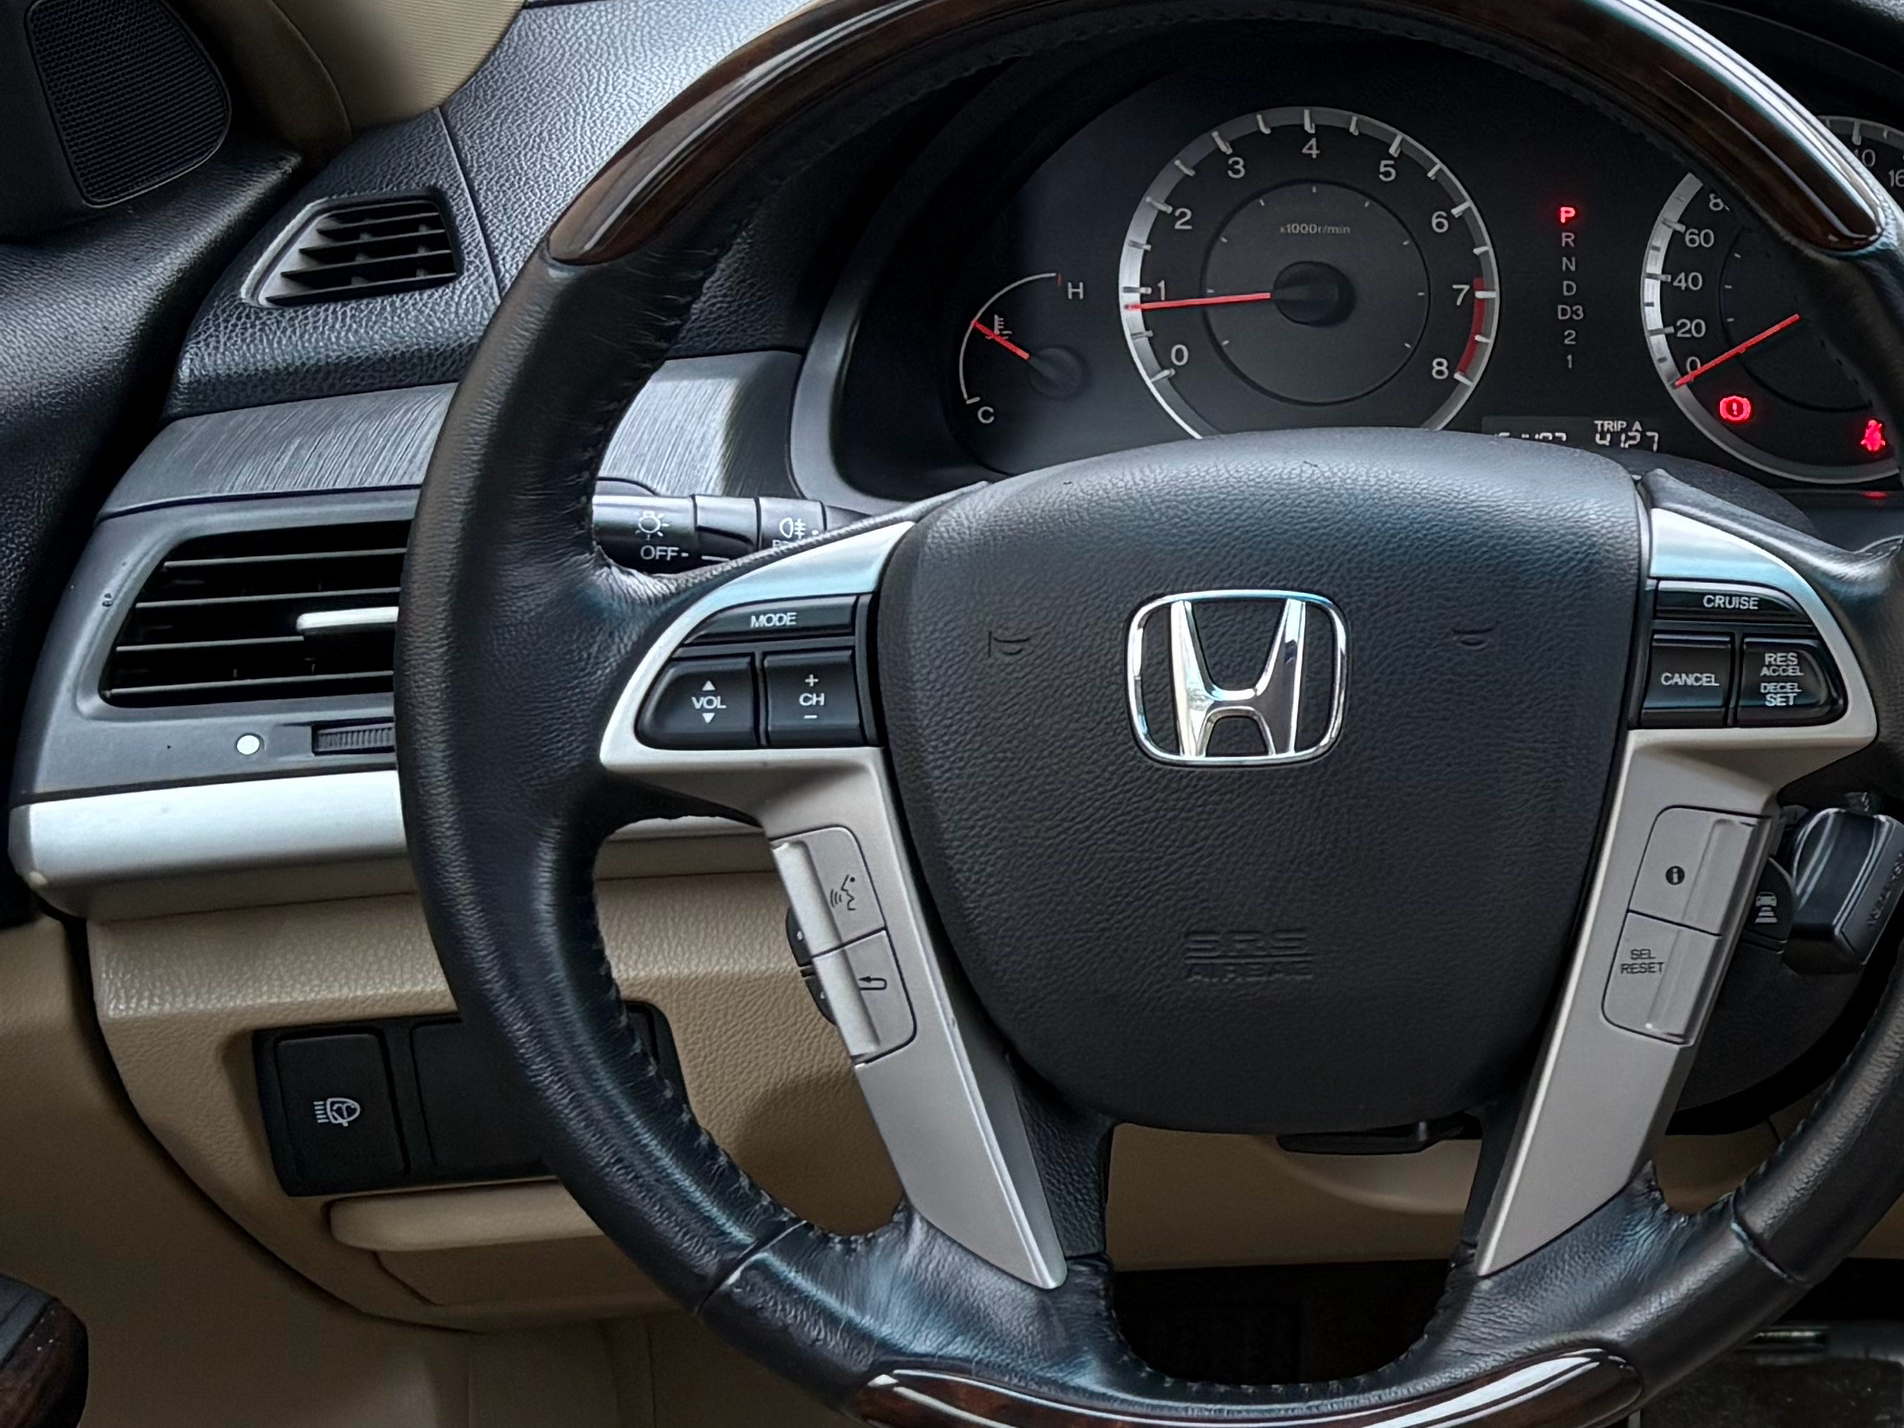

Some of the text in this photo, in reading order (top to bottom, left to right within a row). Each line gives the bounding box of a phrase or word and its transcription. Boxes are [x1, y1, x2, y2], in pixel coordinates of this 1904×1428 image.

[1301, 137, 1321, 159] 4
[1226, 156, 1246, 180] 3
[1378, 159, 1397, 182] 5
[1708, 192, 1730, 212] 8
[1173, 207, 1193, 230] 2
[1430, 210, 1450, 233] 6
[1559, 206, 1576, 224] P
[1561, 231, 1575, 248] R
[1684, 228, 1715, 248] 60
[1562, 256, 1576, 272] N
[1562, 280, 1577, 296] D
[1672, 272, 1703, 291] 40
[1067, 282, 1084, 300] H
[1156, 280, 1167, 301] 1
[1452, 284, 1469, 305] 7
[1557, 304, 1585, 320] D3
[1676, 318, 1706, 338] 20
[1563, 329, 1577, 345] 2
[1170, 344, 1189, 366] 0
[1566, 354, 1573, 369] 1
[1430, 358, 1449, 380] 8
[976, 406, 995, 424] C
[1594, 420, 1643, 432] TRIP A
[640, 545, 679, 562] OFF
[1702, 594, 1760, 610] CRUISE
[749, 612, 797, 628] MODE
[1764, 652, 1798, 666] RES
[1660, 672, 1720, 687] CANCEL
[1760, 666, 1804, 677] ACCEL
[1760, 682, 1802, 693] DECEL
[691, 694, 727, 711] VOL
[799, 691, 826, 708] CH
[1765, 693, 1798, 707] SET
[1630, 948, 1657, 961] SEL
[1620, 962, 1665, 975] RESET
